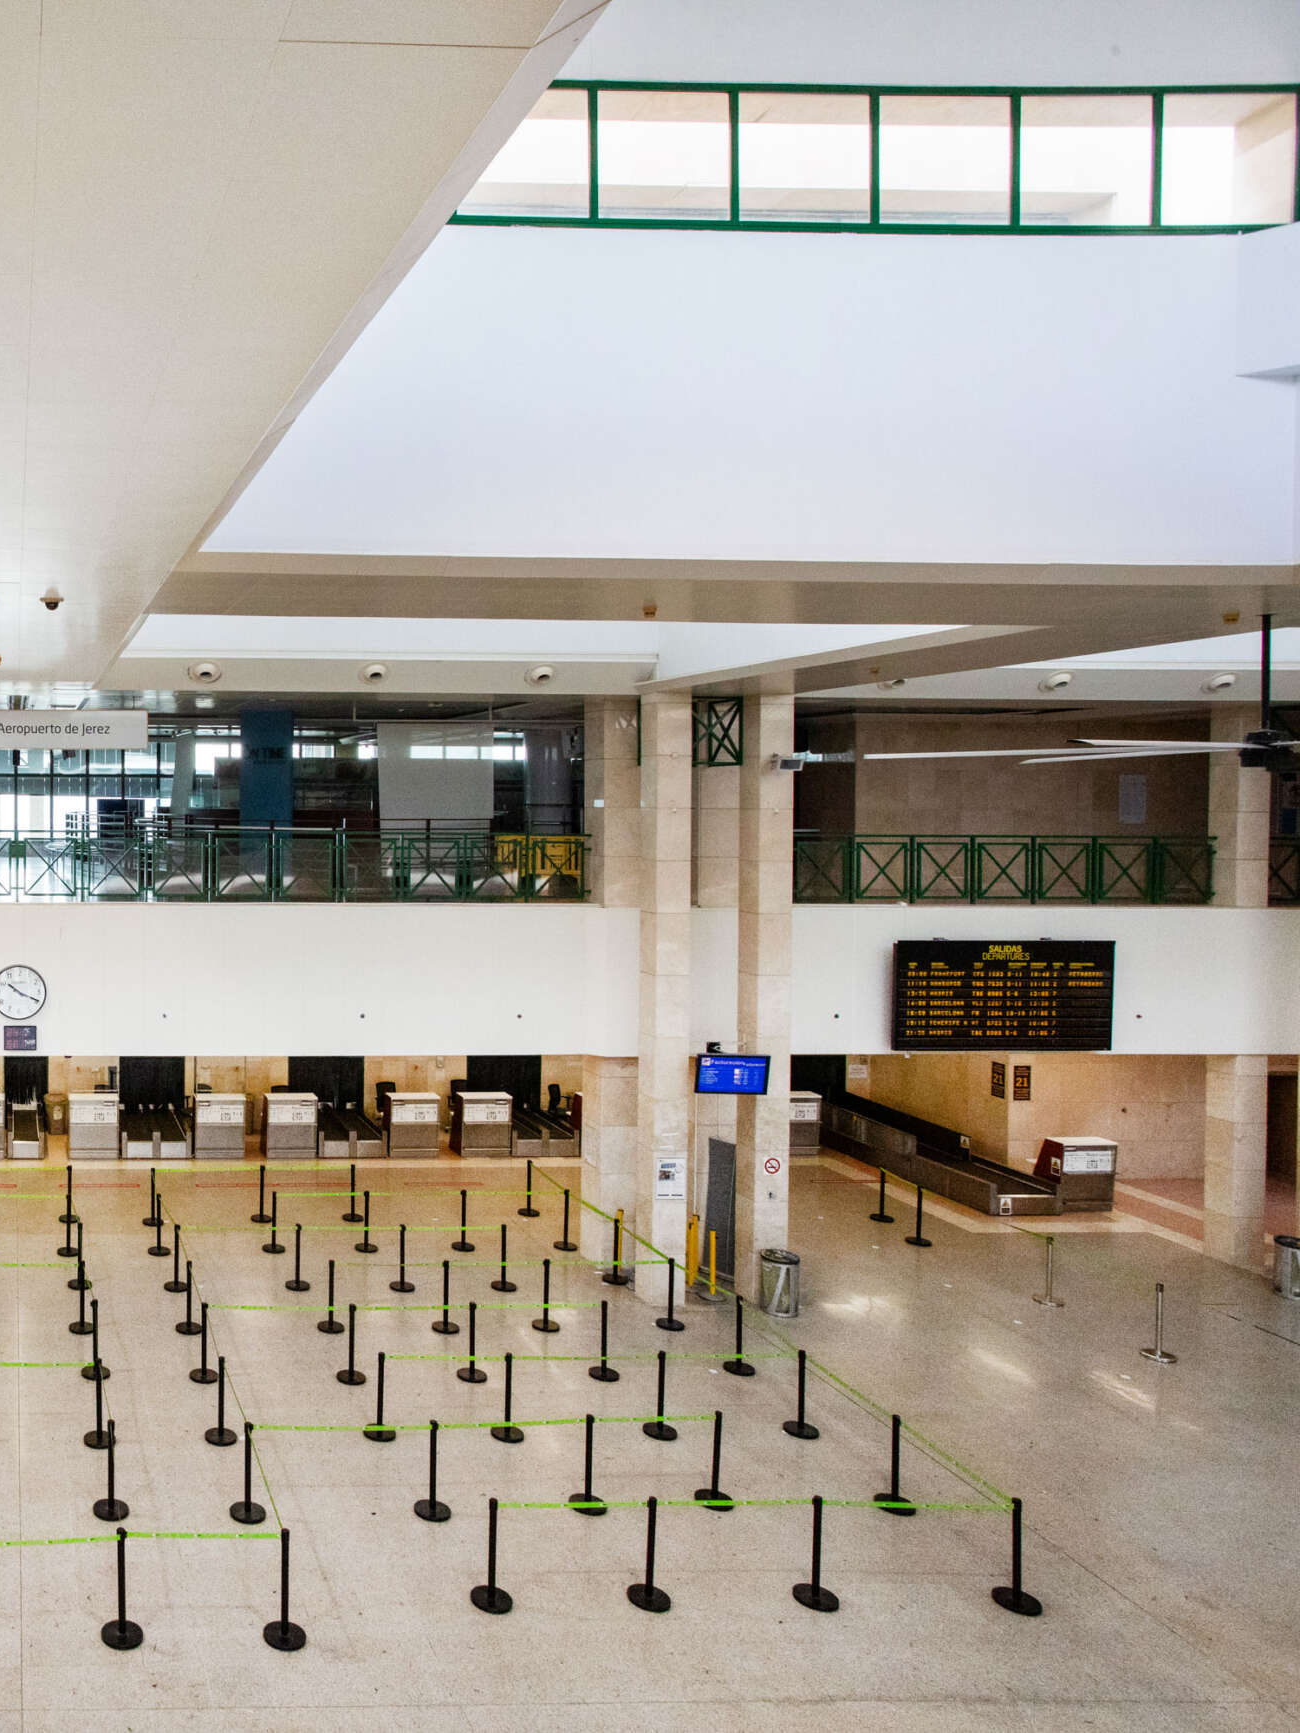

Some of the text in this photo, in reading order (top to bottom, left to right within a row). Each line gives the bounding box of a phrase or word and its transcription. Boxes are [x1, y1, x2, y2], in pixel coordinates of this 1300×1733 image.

[65, 723, 78, 734] de
[81, 723, 110, 736] Jerez
[989, 945, 1022, 953] SALIDAS
[982, 952, 1030, 960] DEPARTURES
[993, 1073, 1003, 1084] 21
[1015, 1077, 1028, 1087] 21
